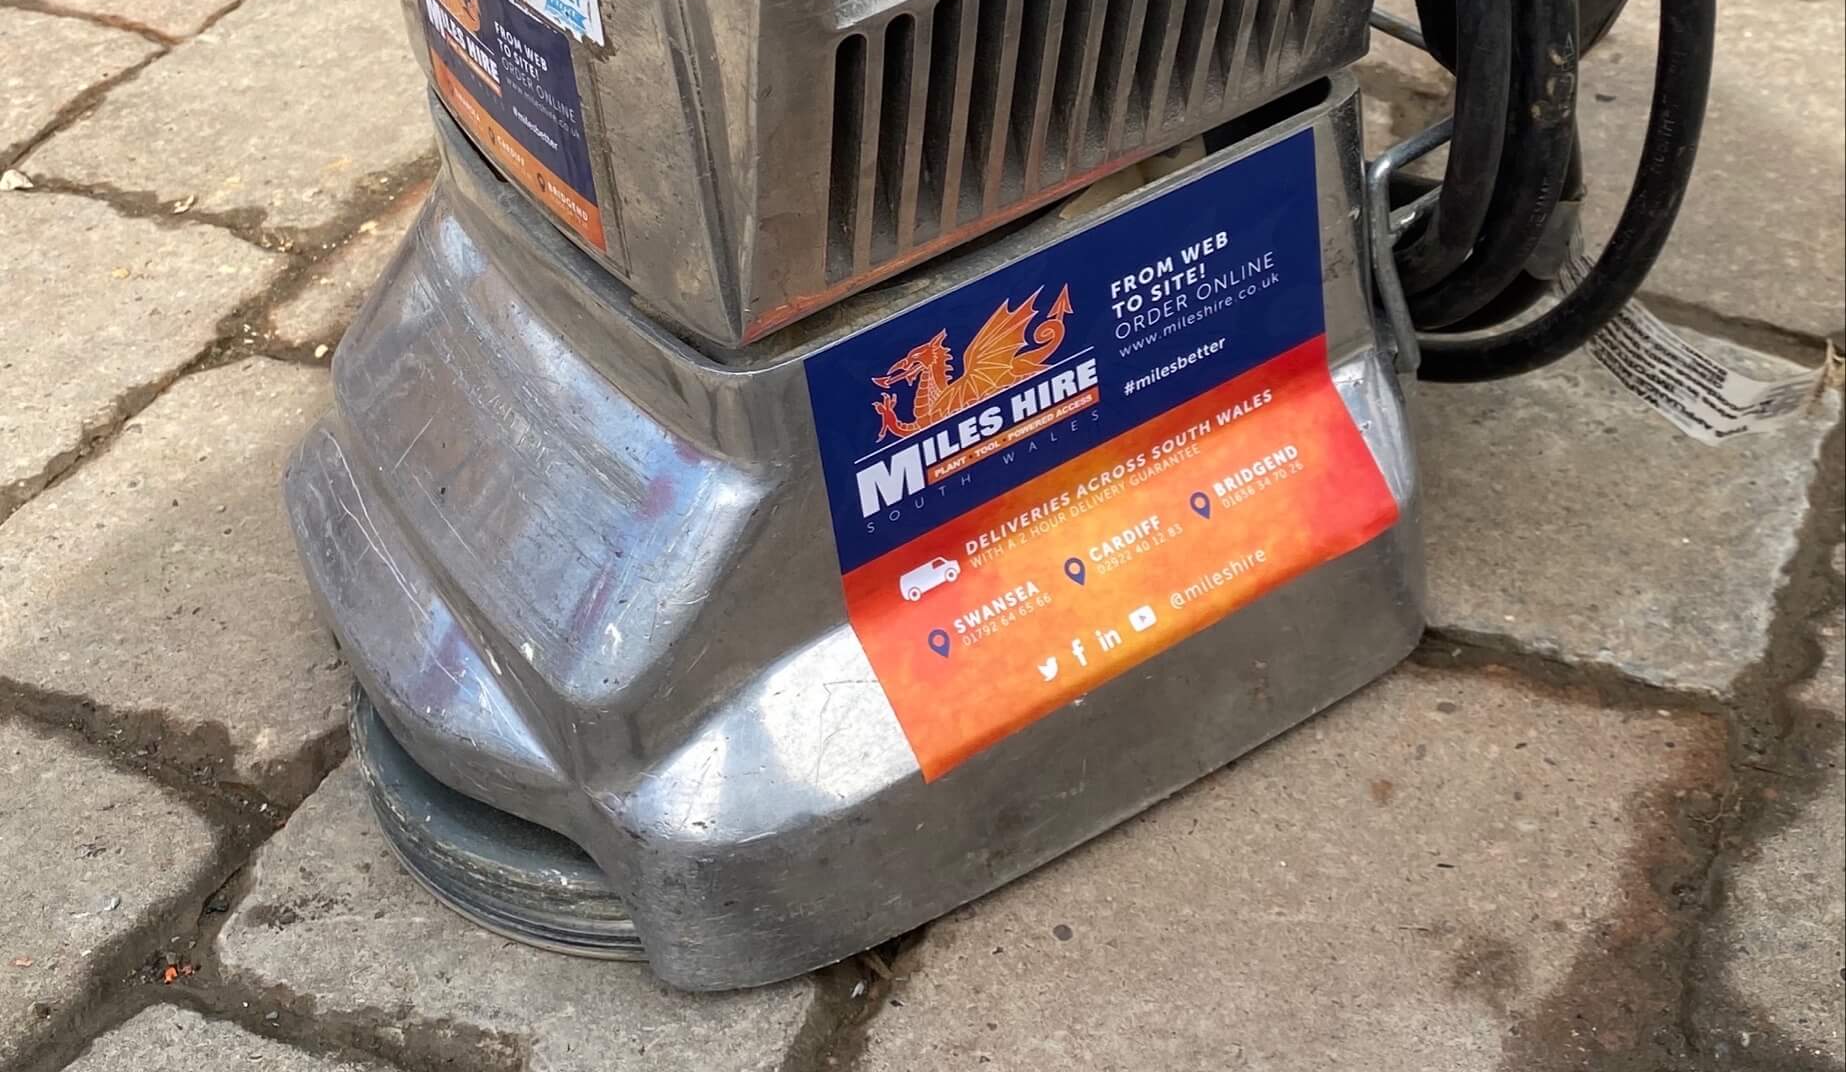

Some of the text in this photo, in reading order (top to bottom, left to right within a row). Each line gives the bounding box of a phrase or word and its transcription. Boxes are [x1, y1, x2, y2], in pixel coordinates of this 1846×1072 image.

[466, 36, 500, 83] HIRE
[494, 20, 548, 72] FROM WEB
[497, 38, 539, 81] TO SITE!
[501, 58, 533, 90] ORDER
[537, 85, 577, 123] ONLINE
[1110, 231, 1229, 299] FROM WEB
[1112, 263, 1206, 319] TO SITE!
[1115, 251, 1275, 339] ORDER ONLINE
[1119, 272, 1280, 357] www.mileshire.co.uk
[1124, 337, 1226, 396] #milesbetter
[855, 358, 1098, 518] MILES HIRE
[934, 394, 1093, 478] PLANT TOOL POWERED ACCESS
[866, 410, 1100, 534] SOUTH WALES
[965, 389, 1273, 556] DELIVERIES ACROSS SOUTH WALES
[1213, 444, 1299, 497] BRIDGEND
[1272, 468, 1288, 481] 70
[970, 543, 1004, 569] WITH
[1007, 538, 1017, 550] A
[1030, 512, 1066, 537] HOUR
[1070, 482, 1126, 517] DELIVERY
[1129, 443, 1201, 486] GUARANTEE
[1088, 515, 1161, 562] CARDIFF
[1135, 540, 1151, 554] 40
[1152, 532, 1167, 546] 12
[953, 580, 1040, 634] SWANSEA
[1169, 548, 1267, 610] @mileshire
[962, 621, 998, 647] 01792
